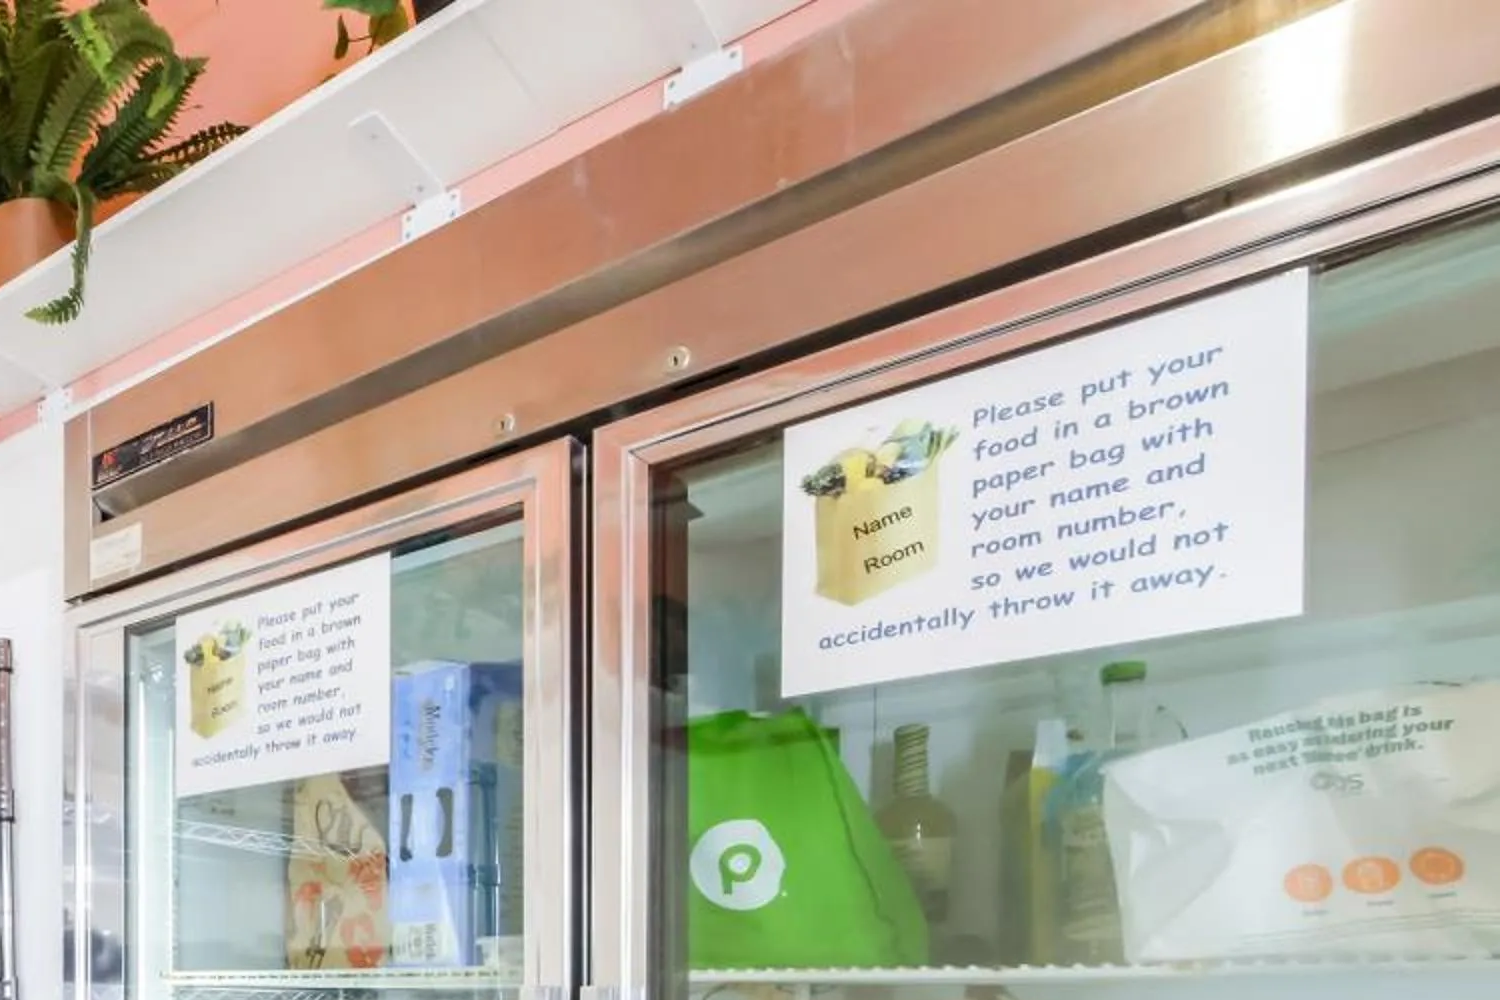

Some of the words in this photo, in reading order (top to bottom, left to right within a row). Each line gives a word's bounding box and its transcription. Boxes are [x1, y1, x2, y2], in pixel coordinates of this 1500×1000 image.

[973, 391, 1065, 428] Please
[1081, 369, 1132, 405] put
[1148, 346, 1223, 385] your
[972, 426, 1039, 461] food
[1054, 420, 1079, 440] in
[1094, 412, 1112, 429] a
[1128, 380, 1229, 420] brown
[972, 460, 1055, 499] paper
[1069, 444, 1125, 469] bag
[1141, 417, 1214, 451] with
[971, 498, 1036, 531] your
[1050, 476, 1130, 508] name
[1146, 453, 1205, 485] and
[853, 505, 914, 541] Name
[971, 530, 1042, 558] room
[1057, 501, 1187, 539] number,
[863, 540, 925, 574] Room
[971, 572, 1001, 590] so
[1015, 561, 1053, 581] we
[1068, 534, 1157, 571] would
[1173, 521, 1229, 550] not
[257, 611, 297, 629] Please
[301, 601, 322, 621] put
[329, 593, 360, 613] your
[321, 615, 361, 635] brown
[819, 607, 975, 650] accidentally
[988, 590, 1076, 619] throw
[1090, 580, 1116, 601] it
[1130, 564, 1228, 594] away.
[257, 655, 292, 676] paper
[297, 647, 322, 662] bag
[326, 635, 355, 654] with
[328, 658, 353, 677] and
[276, 719, 293, 731] we
[297, 707, 334, 726] would
[339, 703, 362, 718] not
[1358, 705, 1399, 724] bag
[1403, 705, 1423, 717] is
[1402, 717, 1456, 736] your
[265, 739, 302, 753] throw
